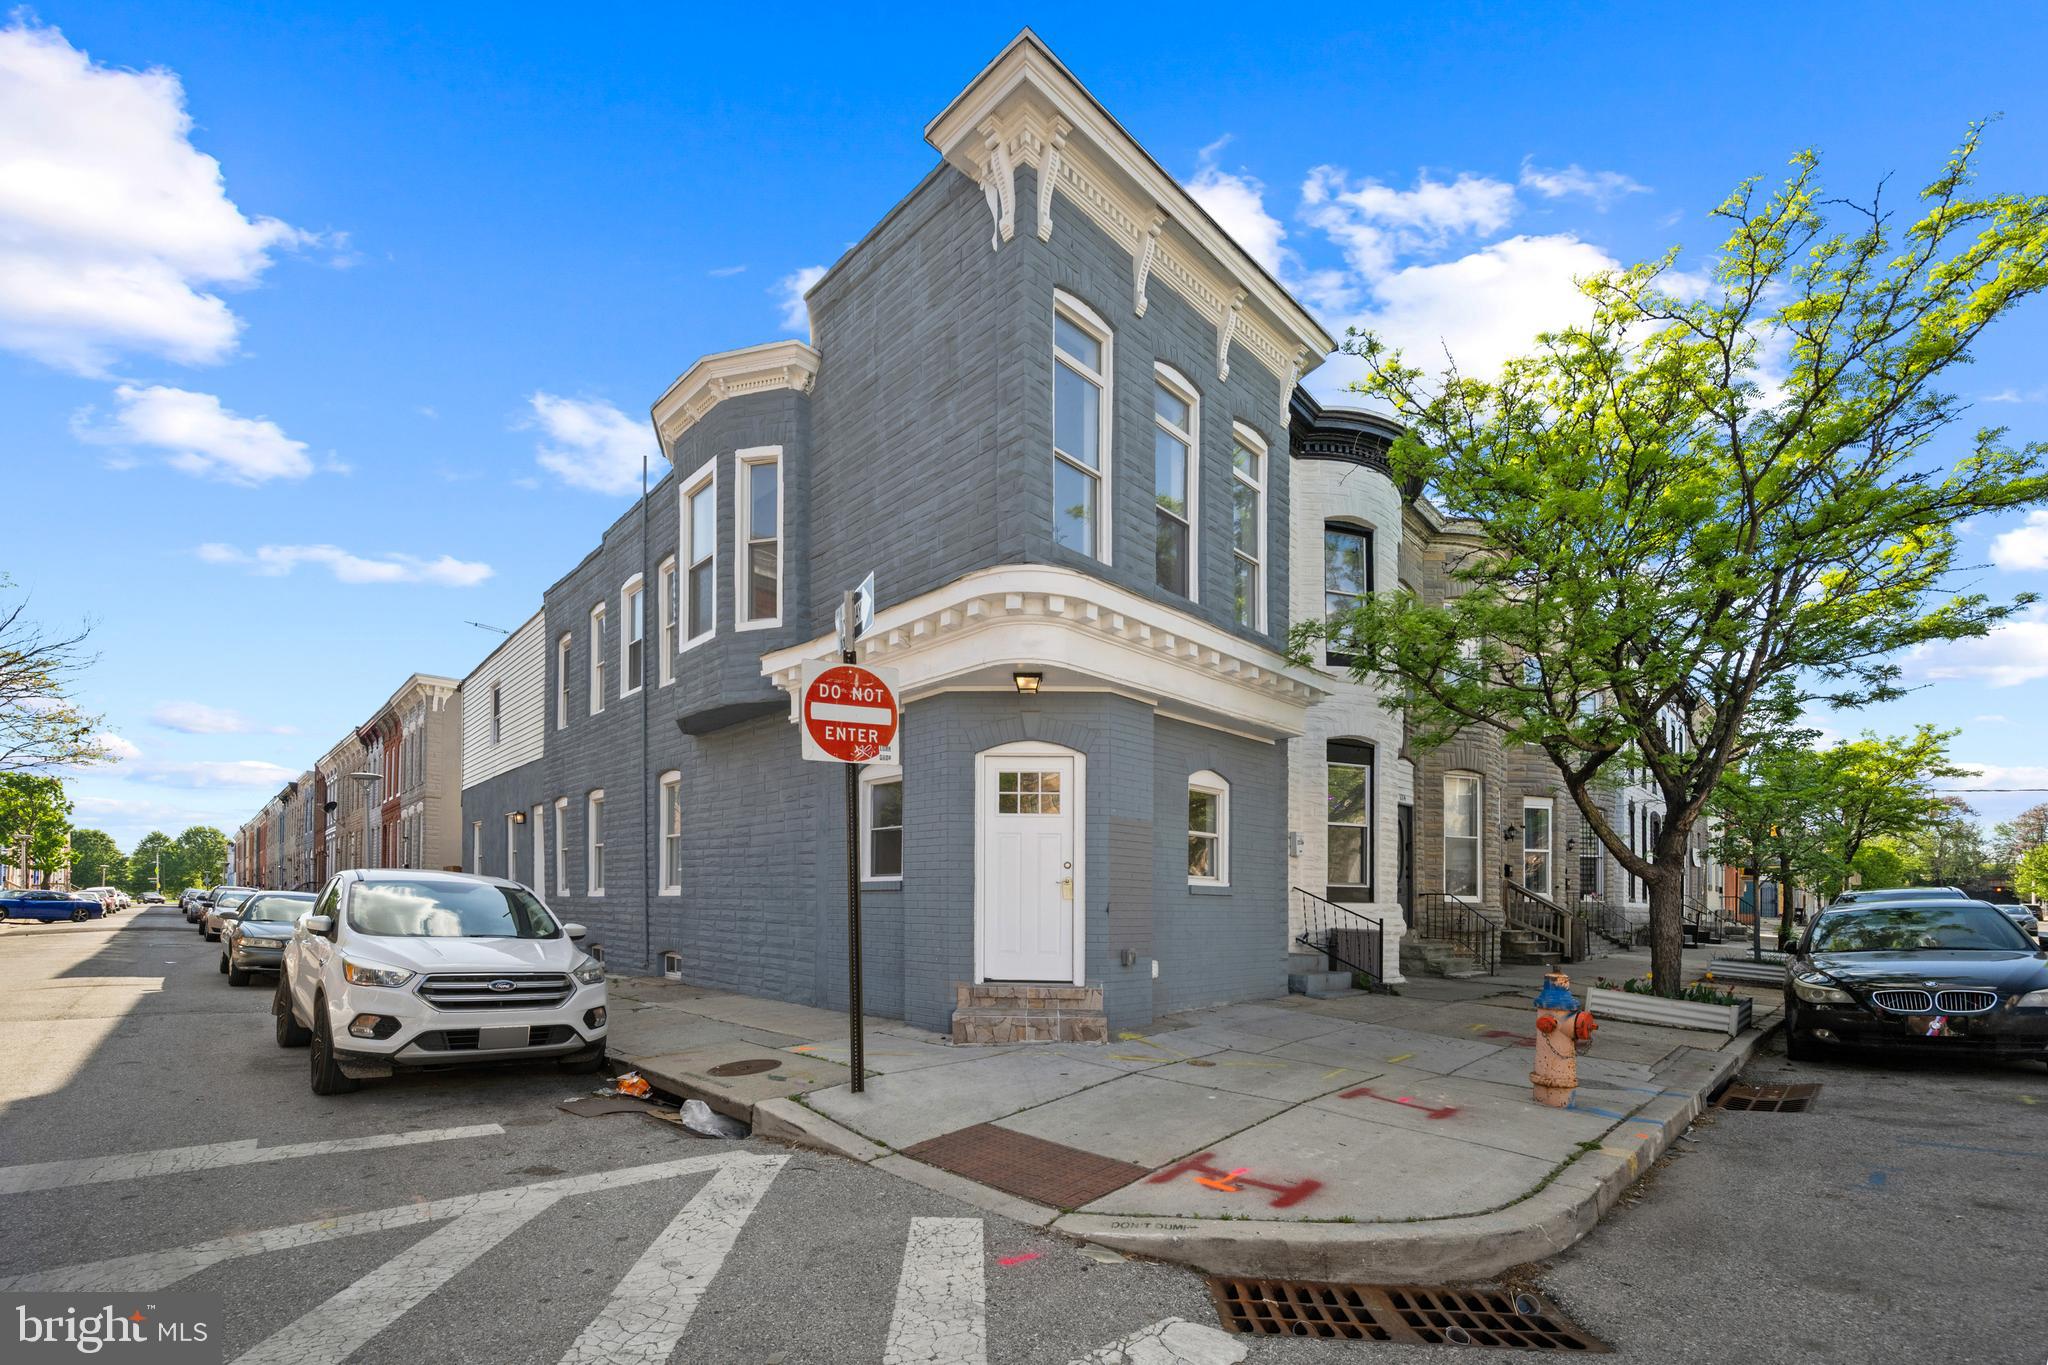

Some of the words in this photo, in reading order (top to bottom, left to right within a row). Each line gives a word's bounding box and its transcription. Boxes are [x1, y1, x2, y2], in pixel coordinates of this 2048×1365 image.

[819, 683, 841, 699] DO
[852, 687, 884, 703] NOT
[825, 726, 878, 744] ENTER
